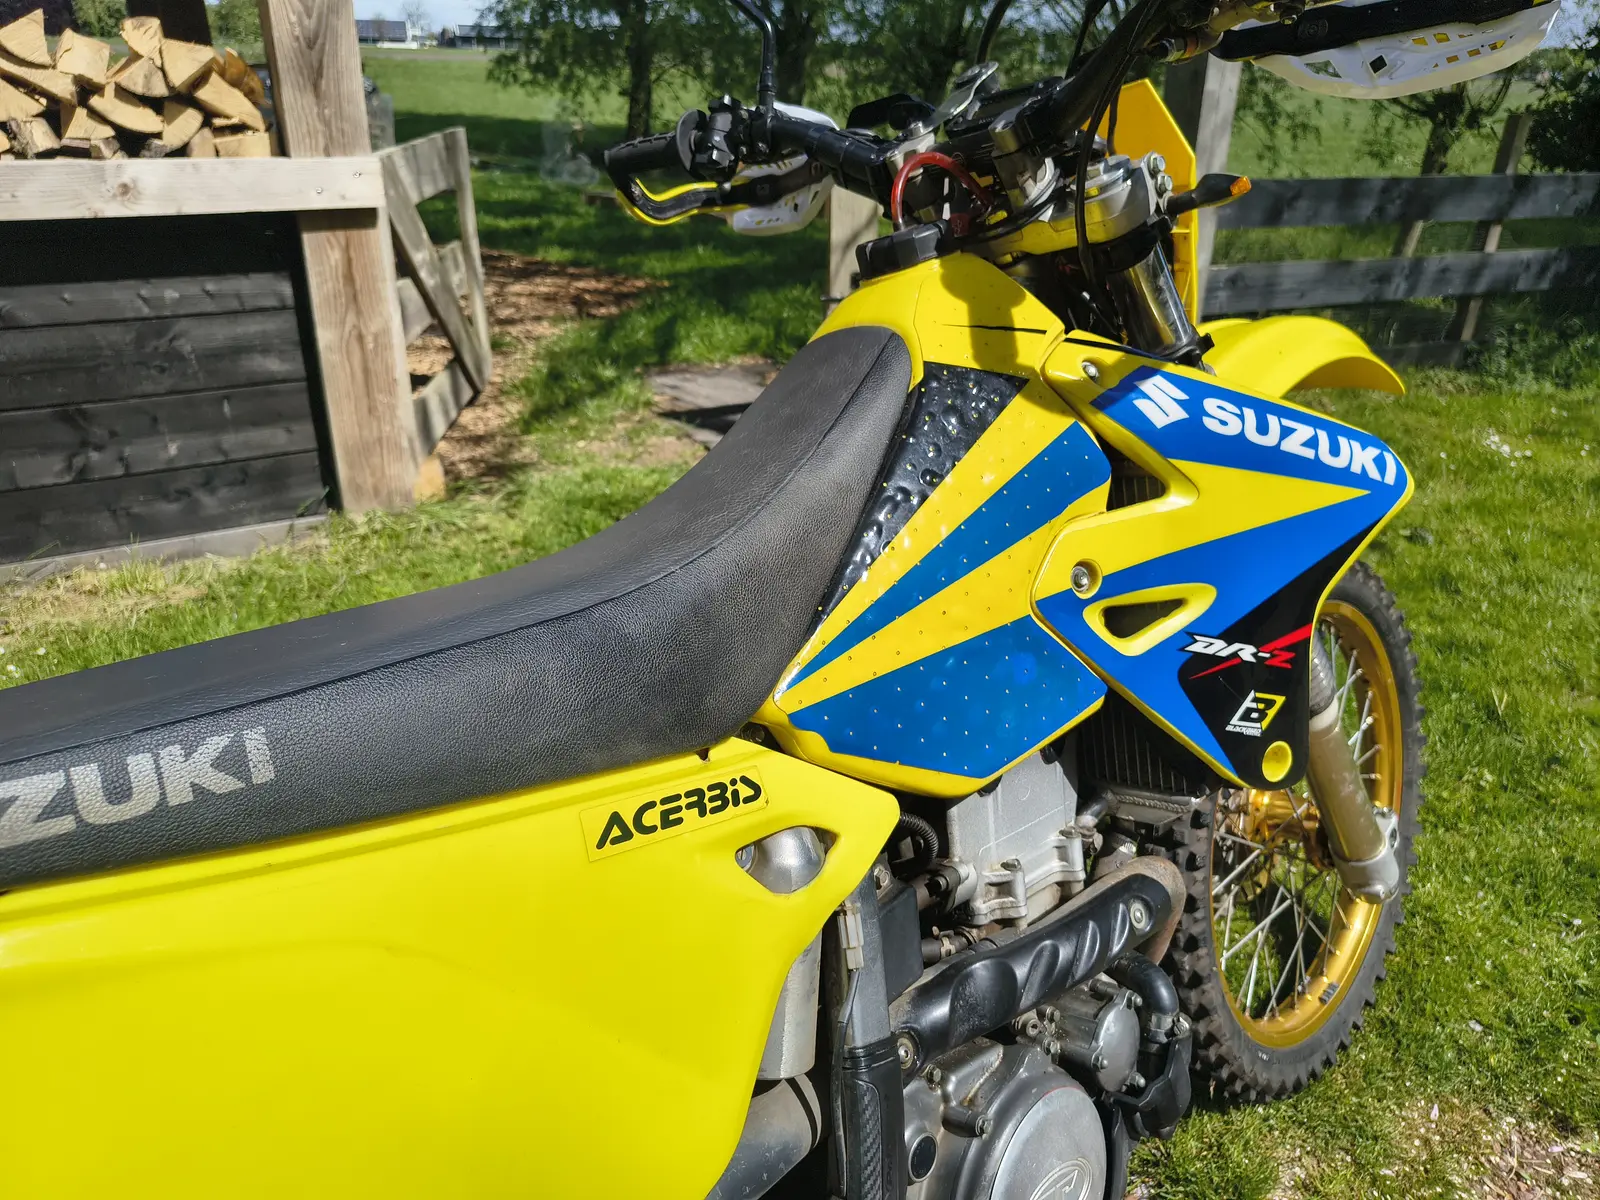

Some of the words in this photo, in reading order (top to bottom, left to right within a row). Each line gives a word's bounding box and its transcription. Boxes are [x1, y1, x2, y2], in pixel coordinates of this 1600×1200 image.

[1202, 398, 1397, 486] SUZUKI
[1184, 635, 1296, 669] DR-Z
[0, 726, 275, 848] ZUKI
